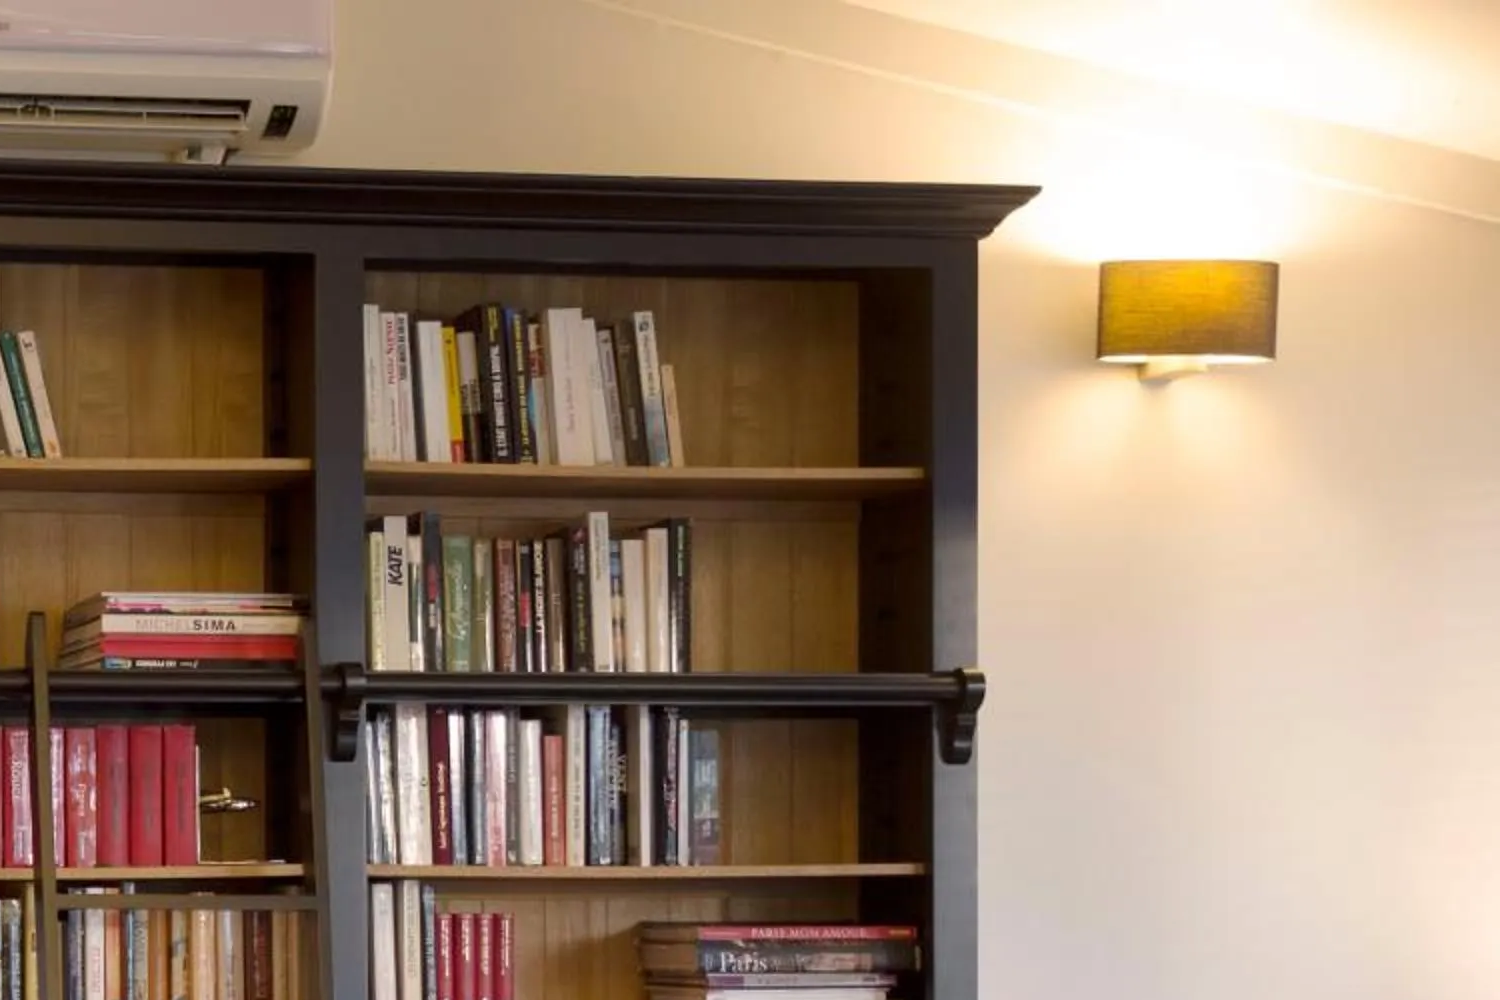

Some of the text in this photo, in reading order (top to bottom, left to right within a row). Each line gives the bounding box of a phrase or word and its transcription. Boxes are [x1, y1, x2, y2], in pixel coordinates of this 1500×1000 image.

[388, 545, 403, 586] KATE
[192, 619, 237, 632] SIMA
[719, 951, 768, 972] Paris
